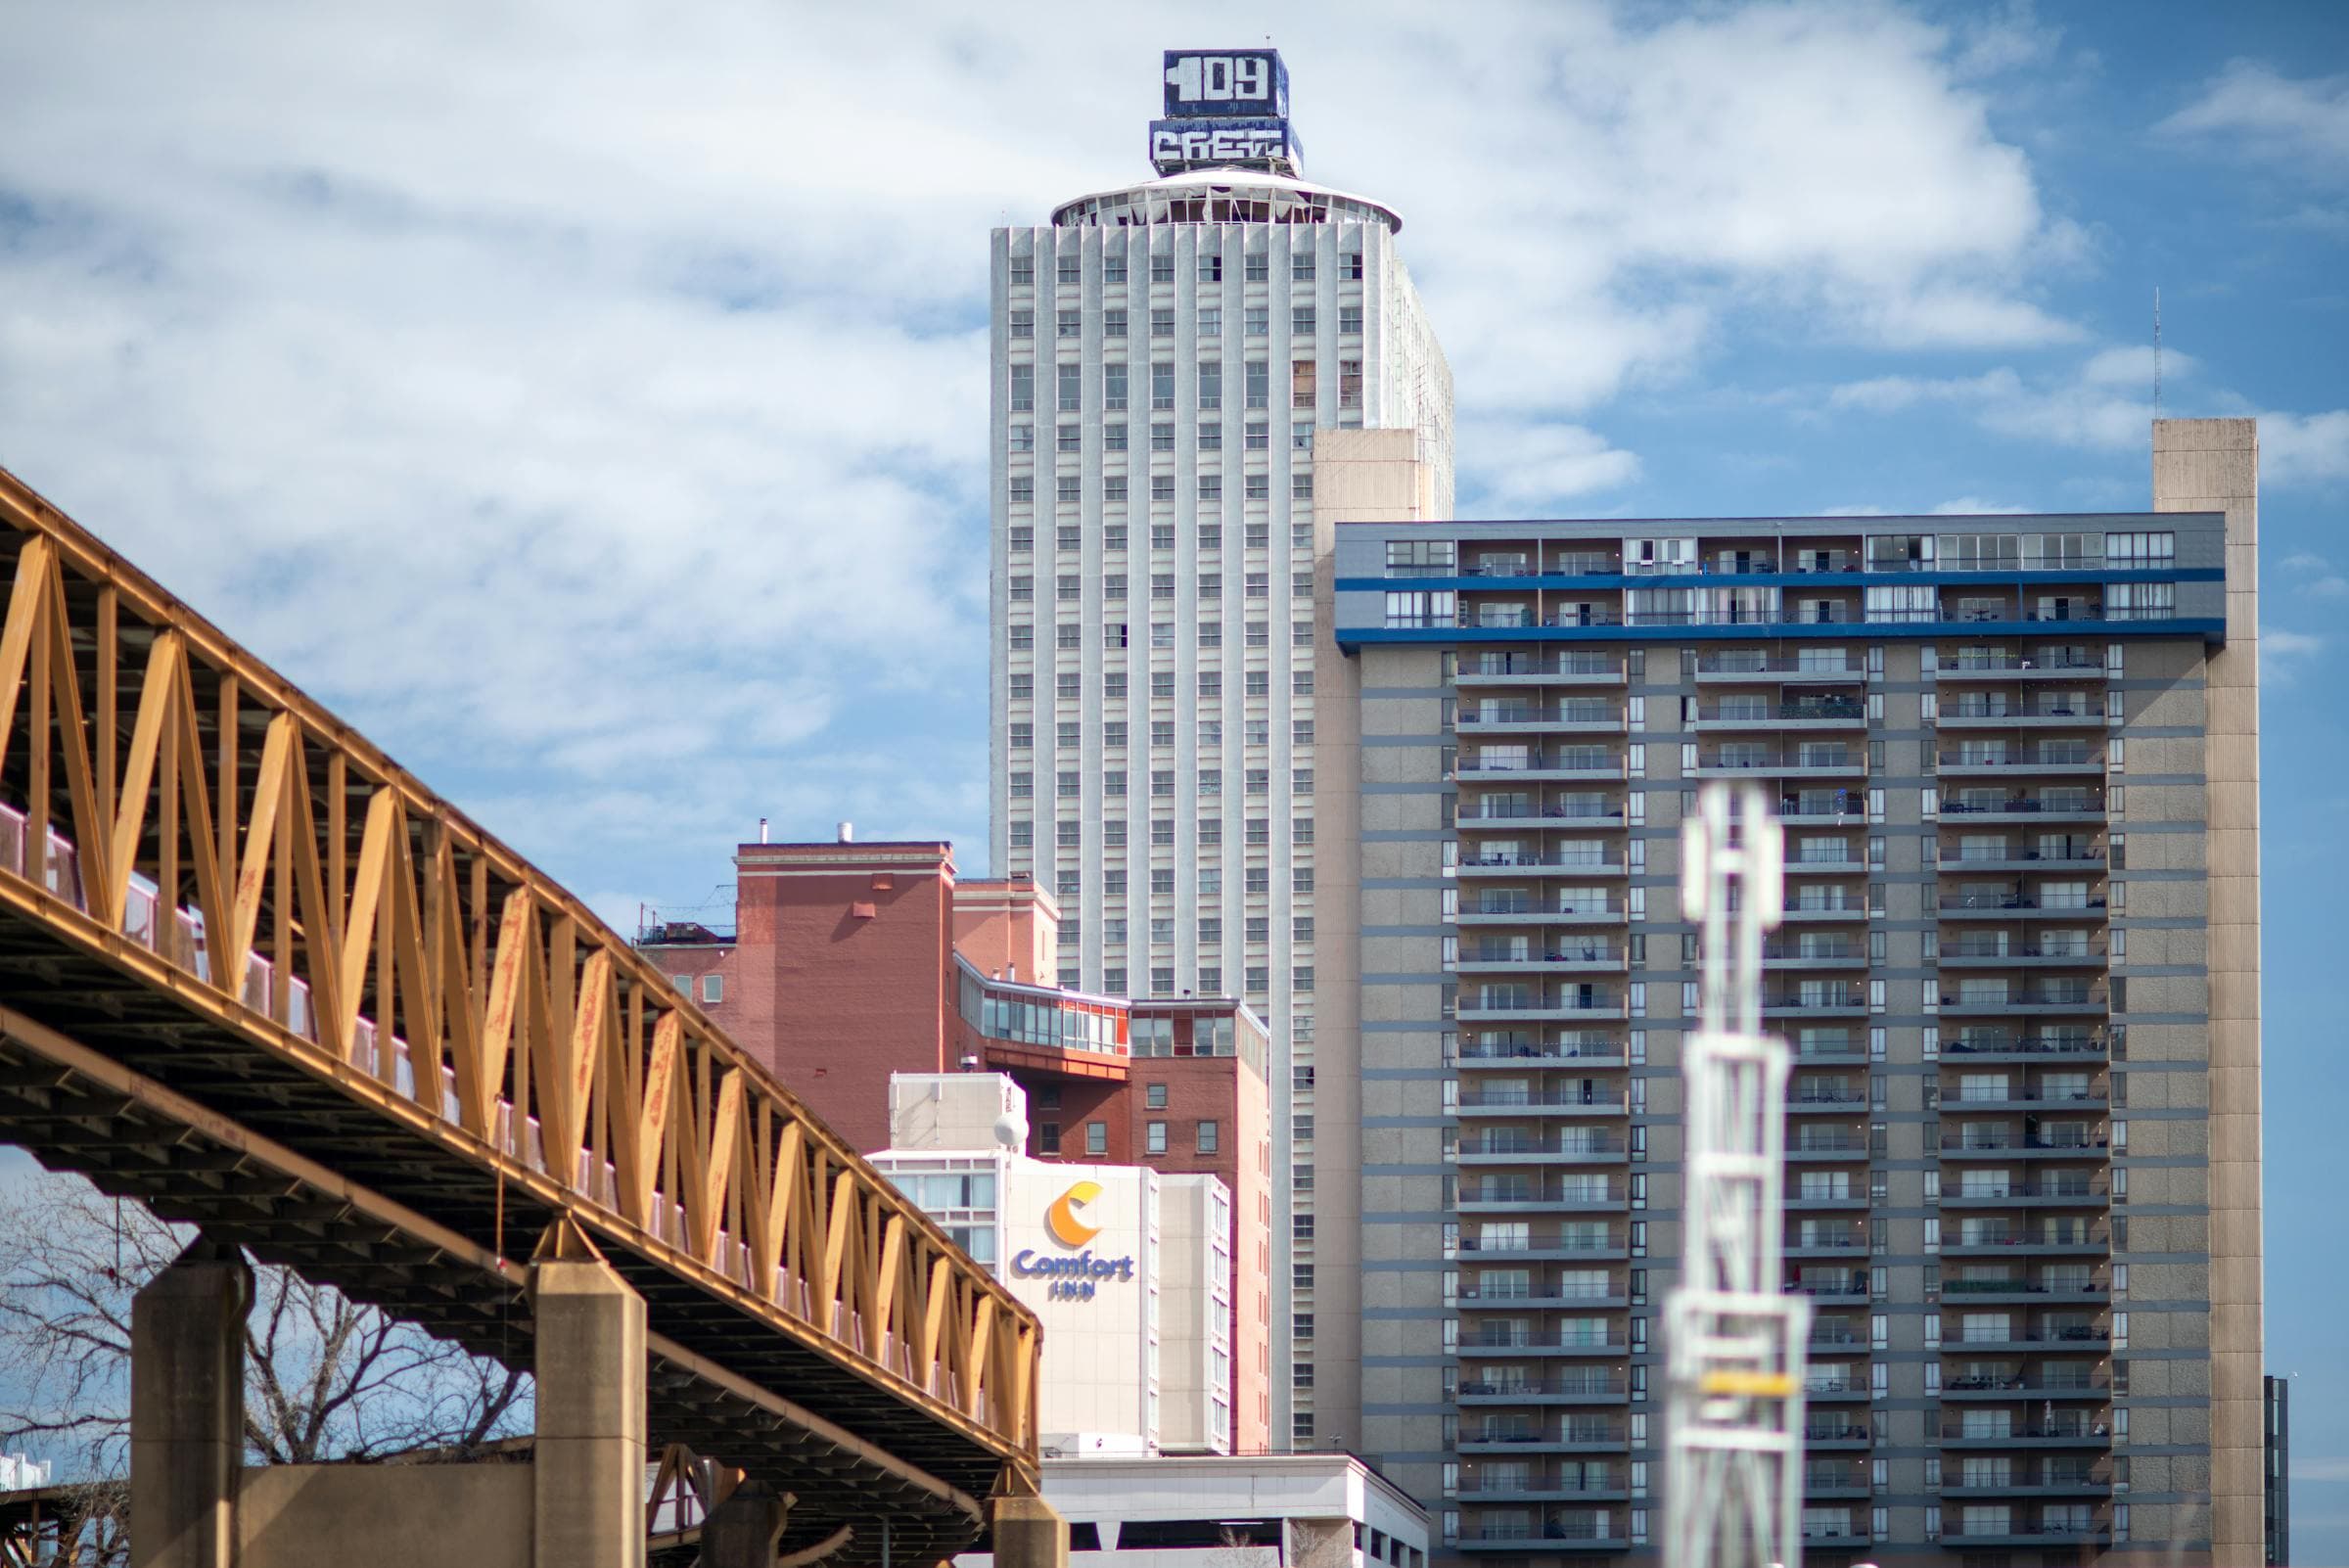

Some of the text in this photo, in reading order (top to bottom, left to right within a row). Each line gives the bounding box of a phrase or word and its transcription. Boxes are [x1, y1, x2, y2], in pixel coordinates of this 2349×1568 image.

[1165, 57, 1268, 102] 109
[1016, 1249, 1134, 1277] Comfort
[1053, 1280, 1095, 1296] INN
